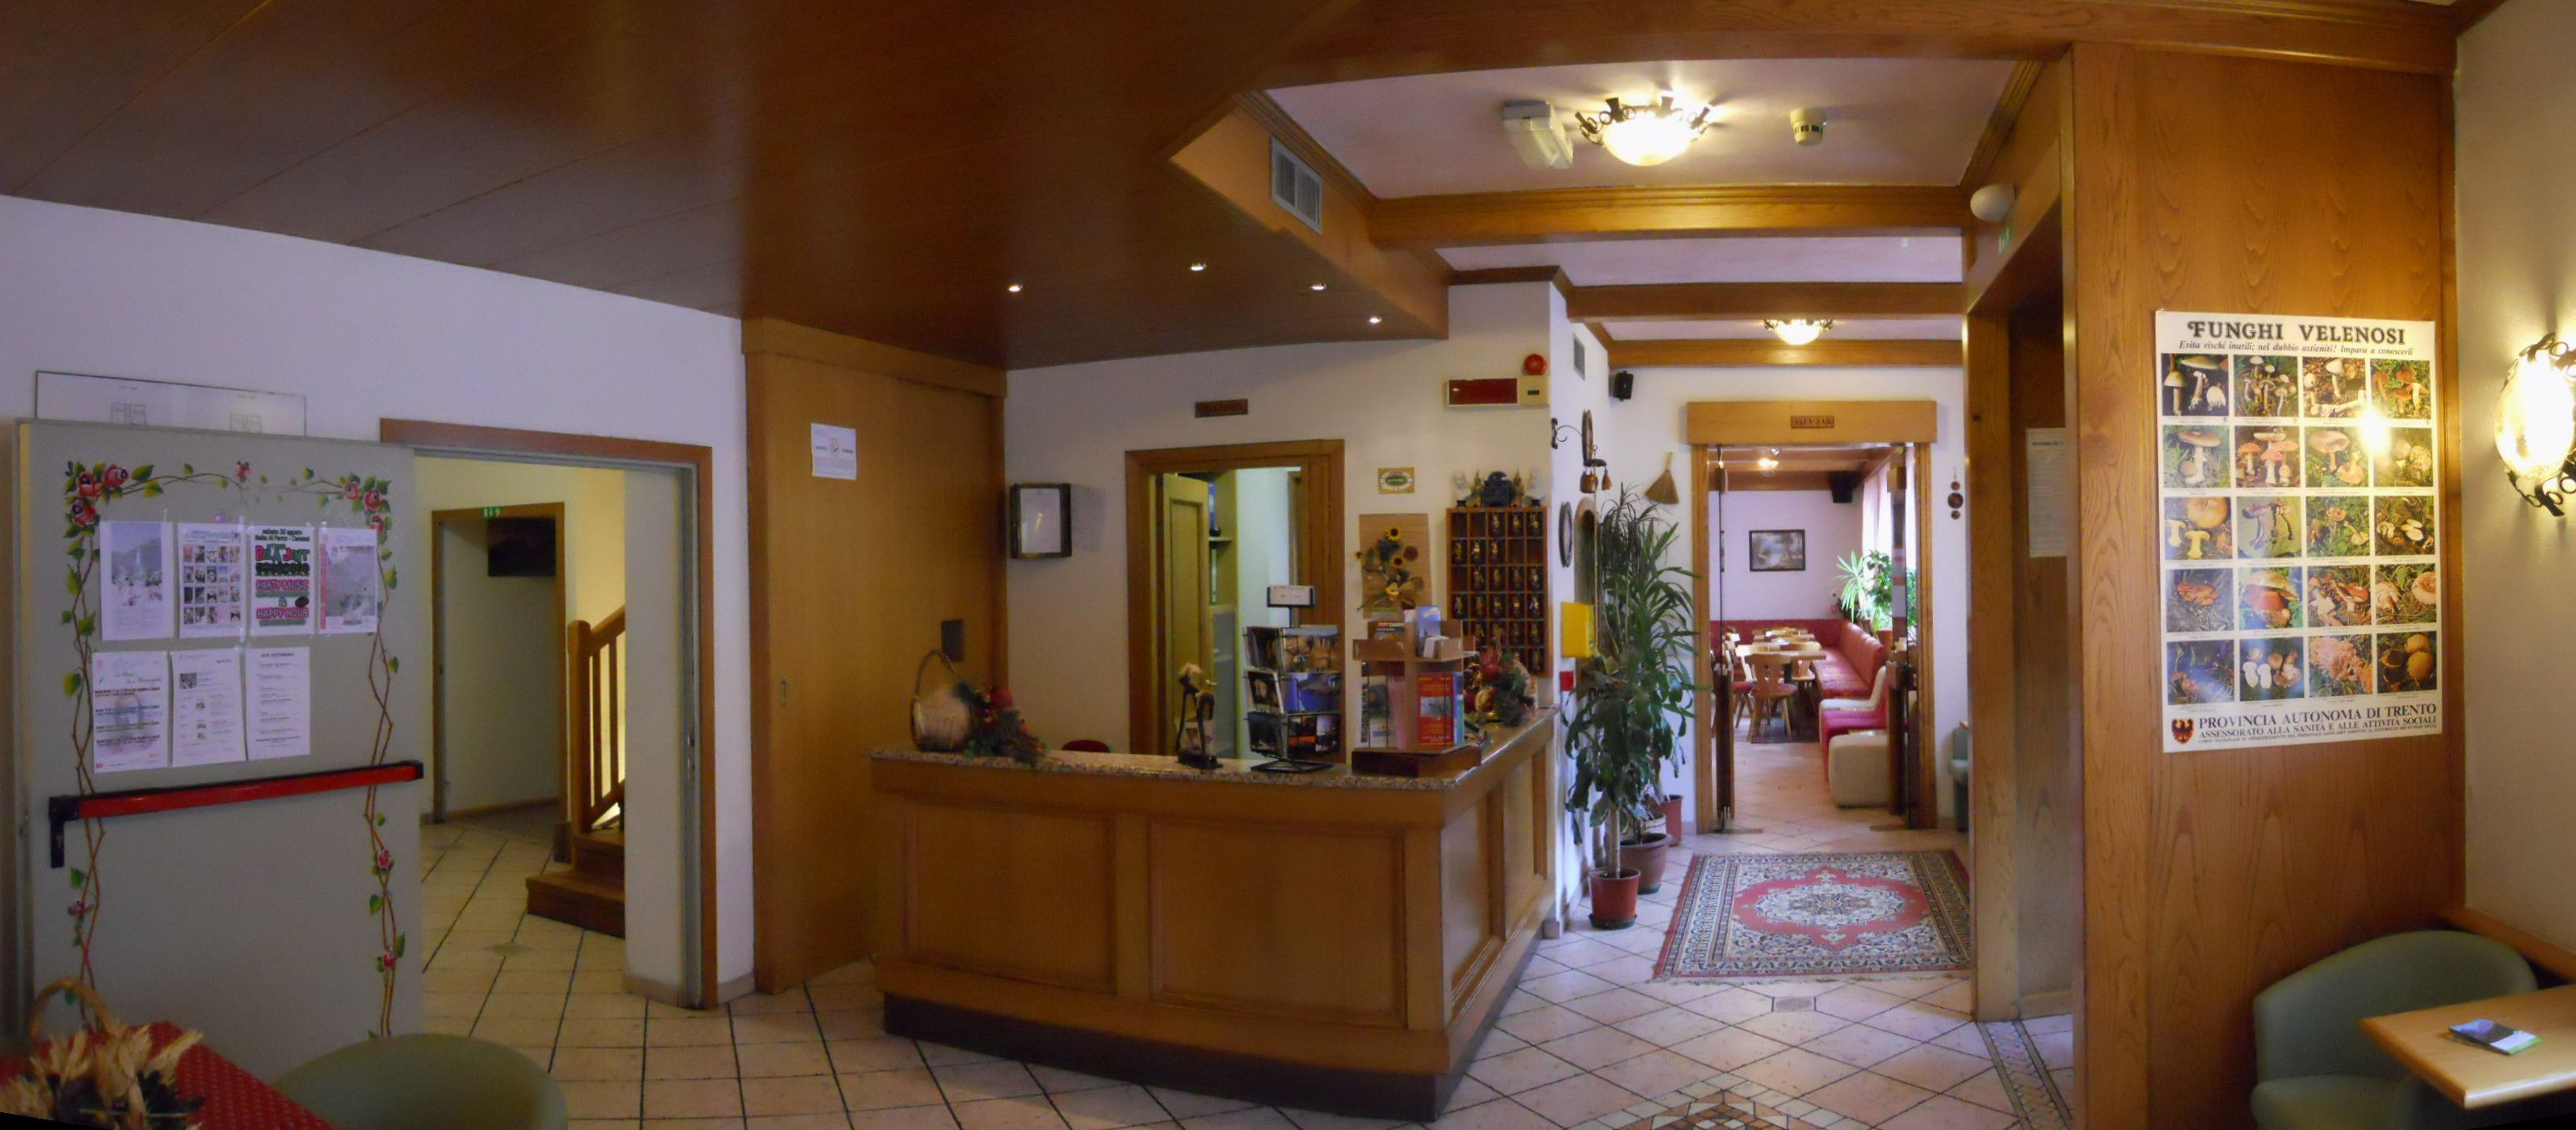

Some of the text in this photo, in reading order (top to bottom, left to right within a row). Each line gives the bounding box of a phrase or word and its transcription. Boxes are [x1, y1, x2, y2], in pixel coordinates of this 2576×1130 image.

[2187, 321, 2406, 345] FUNGHI VELENOSI
[2179, 341, 2200, 349] Evita
[2204, 342, 2225, 350] rischi
[2272, 343, 2299, 351] dubbio
[2302, 344, 2337, 353] astieniti!
[2341, 345, 2367, 355] Impara
[2378, 347, 2414, 355] conoscerli
[256, 579, 309, 590] PARTY MUSIC
[256, 607, 309, 620] HAPPY HOUR
[2199, 703, 2437, 729] PROVINCIA AUTONOMA DI TRENTO
[2200, 728, 2264, 739] ASSESSORATO
[2267, 725, 2291, 735] ALLA
[2329, 723, 2334, 731] E
[2339, 720, 2360, 730] ALLE
[2402, 716, 2437, 725] SOCIALI
